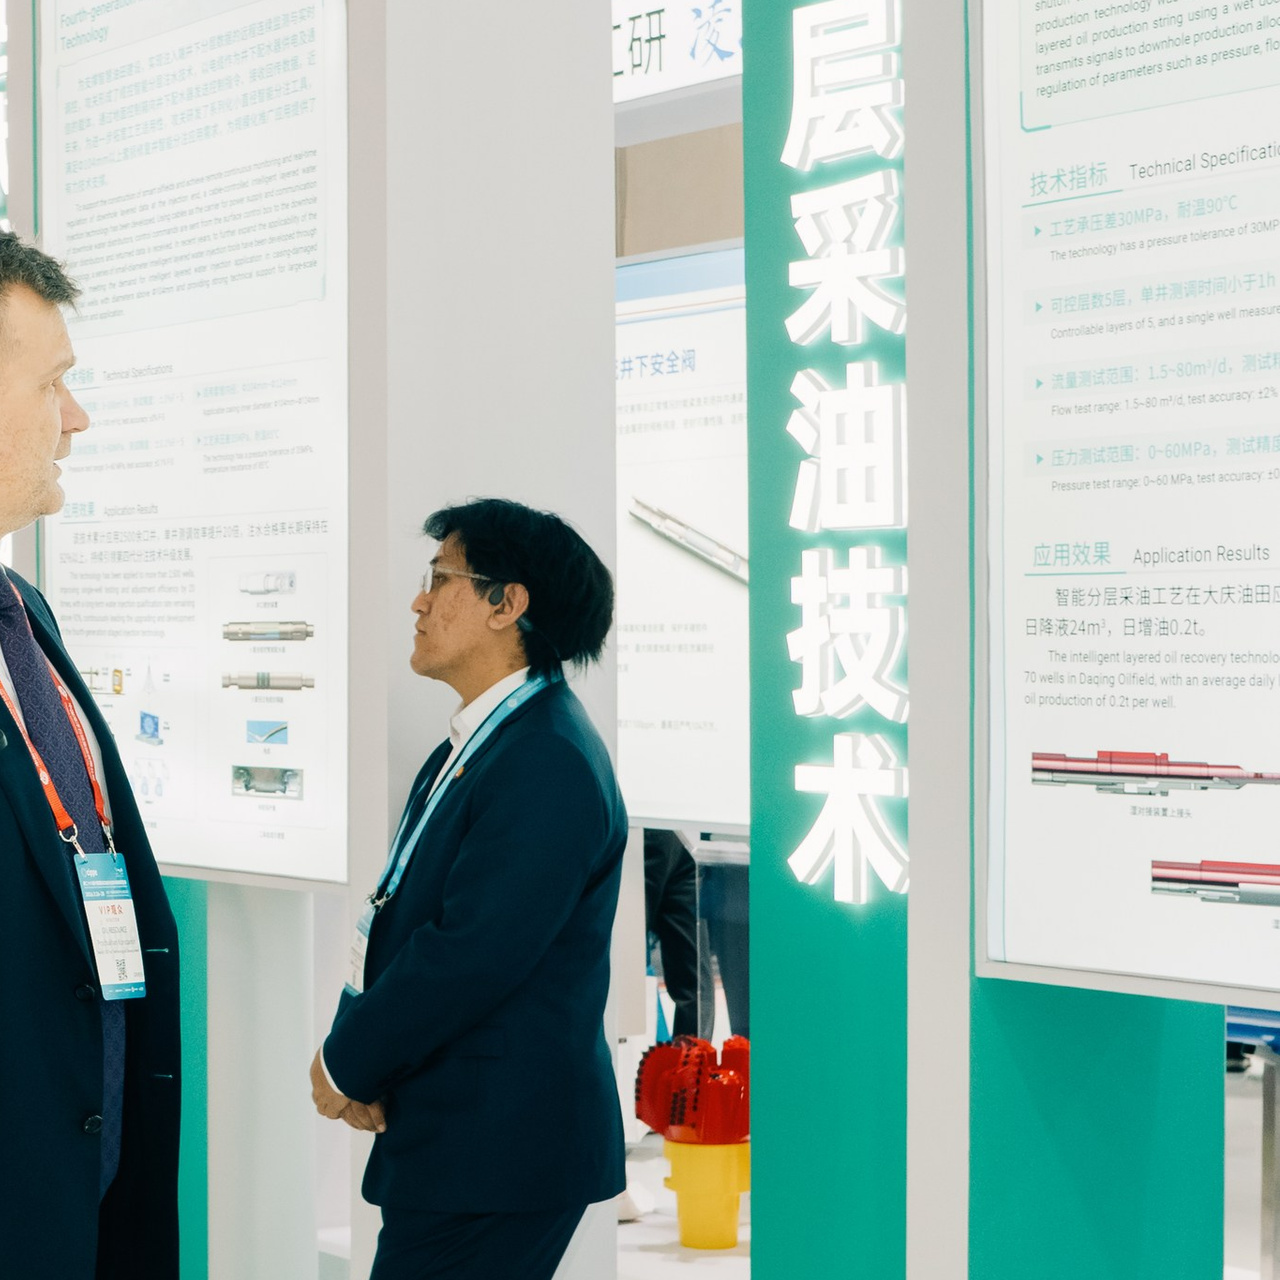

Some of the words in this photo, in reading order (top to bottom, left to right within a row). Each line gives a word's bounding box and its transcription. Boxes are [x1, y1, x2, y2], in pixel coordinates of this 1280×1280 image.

[1034, 11, 1090, 34] production
[1035, 34, 1072, 55] layered
[1075, 30, 1088, 46] oil
[1091, 20, 1149, 45] production
[1152, 13, 1184, 29] string
[1187, 6, 1218, 22] using
[1221, 3, 1229, 15] a
[61, 25, 108, 51] Technology
[1035, 56, 1084, 75] transmits
[1085, 46, 1124, 67] signals
[1124, 45, 1136, 57] to
[1137, 32, 1191, 54] downhole
[1192, 21, 1254, 47] production
[1035, 77, 1087, 98] regulation
[1088, 71, 1100, 86] of
[1102, 62, 1163, 86] parameters
[1165, 54, 1192, 71] such
[1194, 53, 1208, 66] as
[1210, 43, 1263, 65] pressure,
[1029, 160, 1108, 197] 技术指标
[1128, 153, 1196, 179] Technical
[1049, 249, 1067, 261] The
[1067, 243, 1118, 259] technology
[1119, 240, 1137, 251] has
[1138, 239, 1145, 249] a
[1146, 233, 1188, 250] pressure
[1189, 226, 1236, 242] tolerance
[1236, 222, 1248, 236] of
[1050, 322, 1105, 340] Controllable
[1105, 320, 1134, 335] layers
[1134, 316, 1146, 330] of
[1157, 314, 1176, 327] and
[1177, 315, 1184, 325] a
[1185, 309, 1215, 325] single
[1216, 306, 1237, 320] well
[103, 368, 131, 382] Technical
[615, 350, 697, 381] 井下安全阀
[104, 505, 136, 518] Application
[137, 503, 158, 515] Results
[1033, 540, 1111, 567] 应用效果
[1132, 546, 1212, 567] Application
[1216, 543, 1270, 562] Results
[1047, 649, 1068, 662] The
[1069, 650, 1120, 666] intelligent
[1122, 650, 1162, 666] layered
[1163, 650, 1177, 663] oil
[1179, 652, 1228, 666] recovery
[1023, 670, 1037, 683] 70
[1038, 671, 1065, 684] wells
[1066, 673, 1077, 684] in
[1078, 671, 1116, 688] Daqing
[1117, 671, 1157, 686] Oilfield,
[1159, 672, 1183, 686] with
[1185, 675, 1199, 686] an
[1201, 675, 1246, 690] average
[1248, 673, 1276, 690] daily
[1023, 692, 1036, 704] oil
[1038, 692, 1093, 707] production
[1094, 693, 1107, 707] of
[1108, 694, 1130, 708] 0.2t
[1131, 697, 1150, 710] per
[1151, 695, 1176, 708] well.
